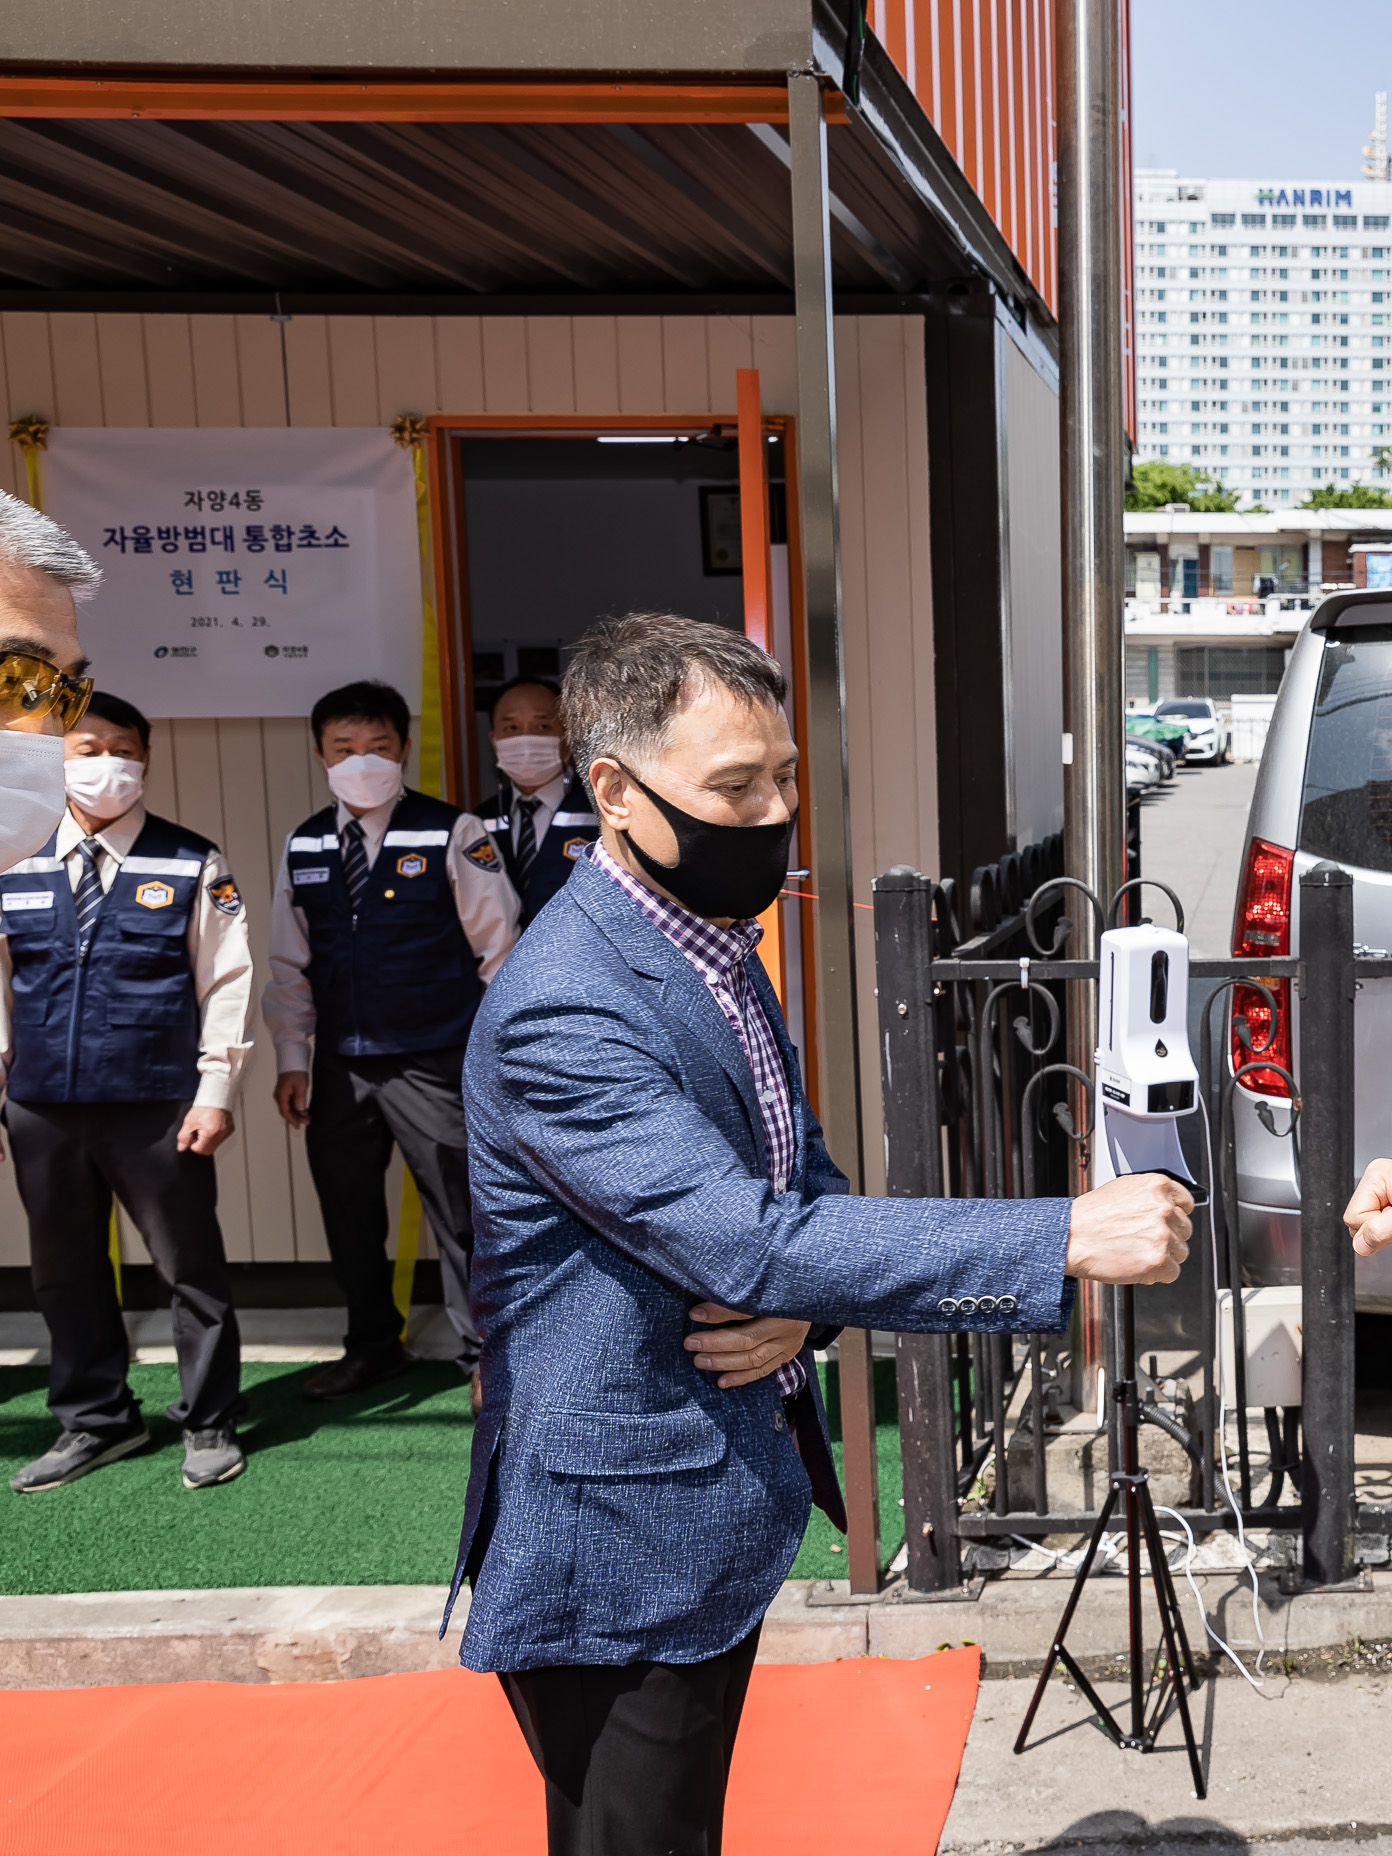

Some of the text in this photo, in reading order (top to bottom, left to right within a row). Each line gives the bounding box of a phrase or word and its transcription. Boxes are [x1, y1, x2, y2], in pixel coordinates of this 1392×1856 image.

[1257, 188, 1352, 208] HANRIM
[183, 489, 265, 513] 자양4동
[102, 524, 350, 554] 자율방범대 통합초소
[169, 568, 288, 596] 현 판 식
[190, 616, 224, 629] 2021.
